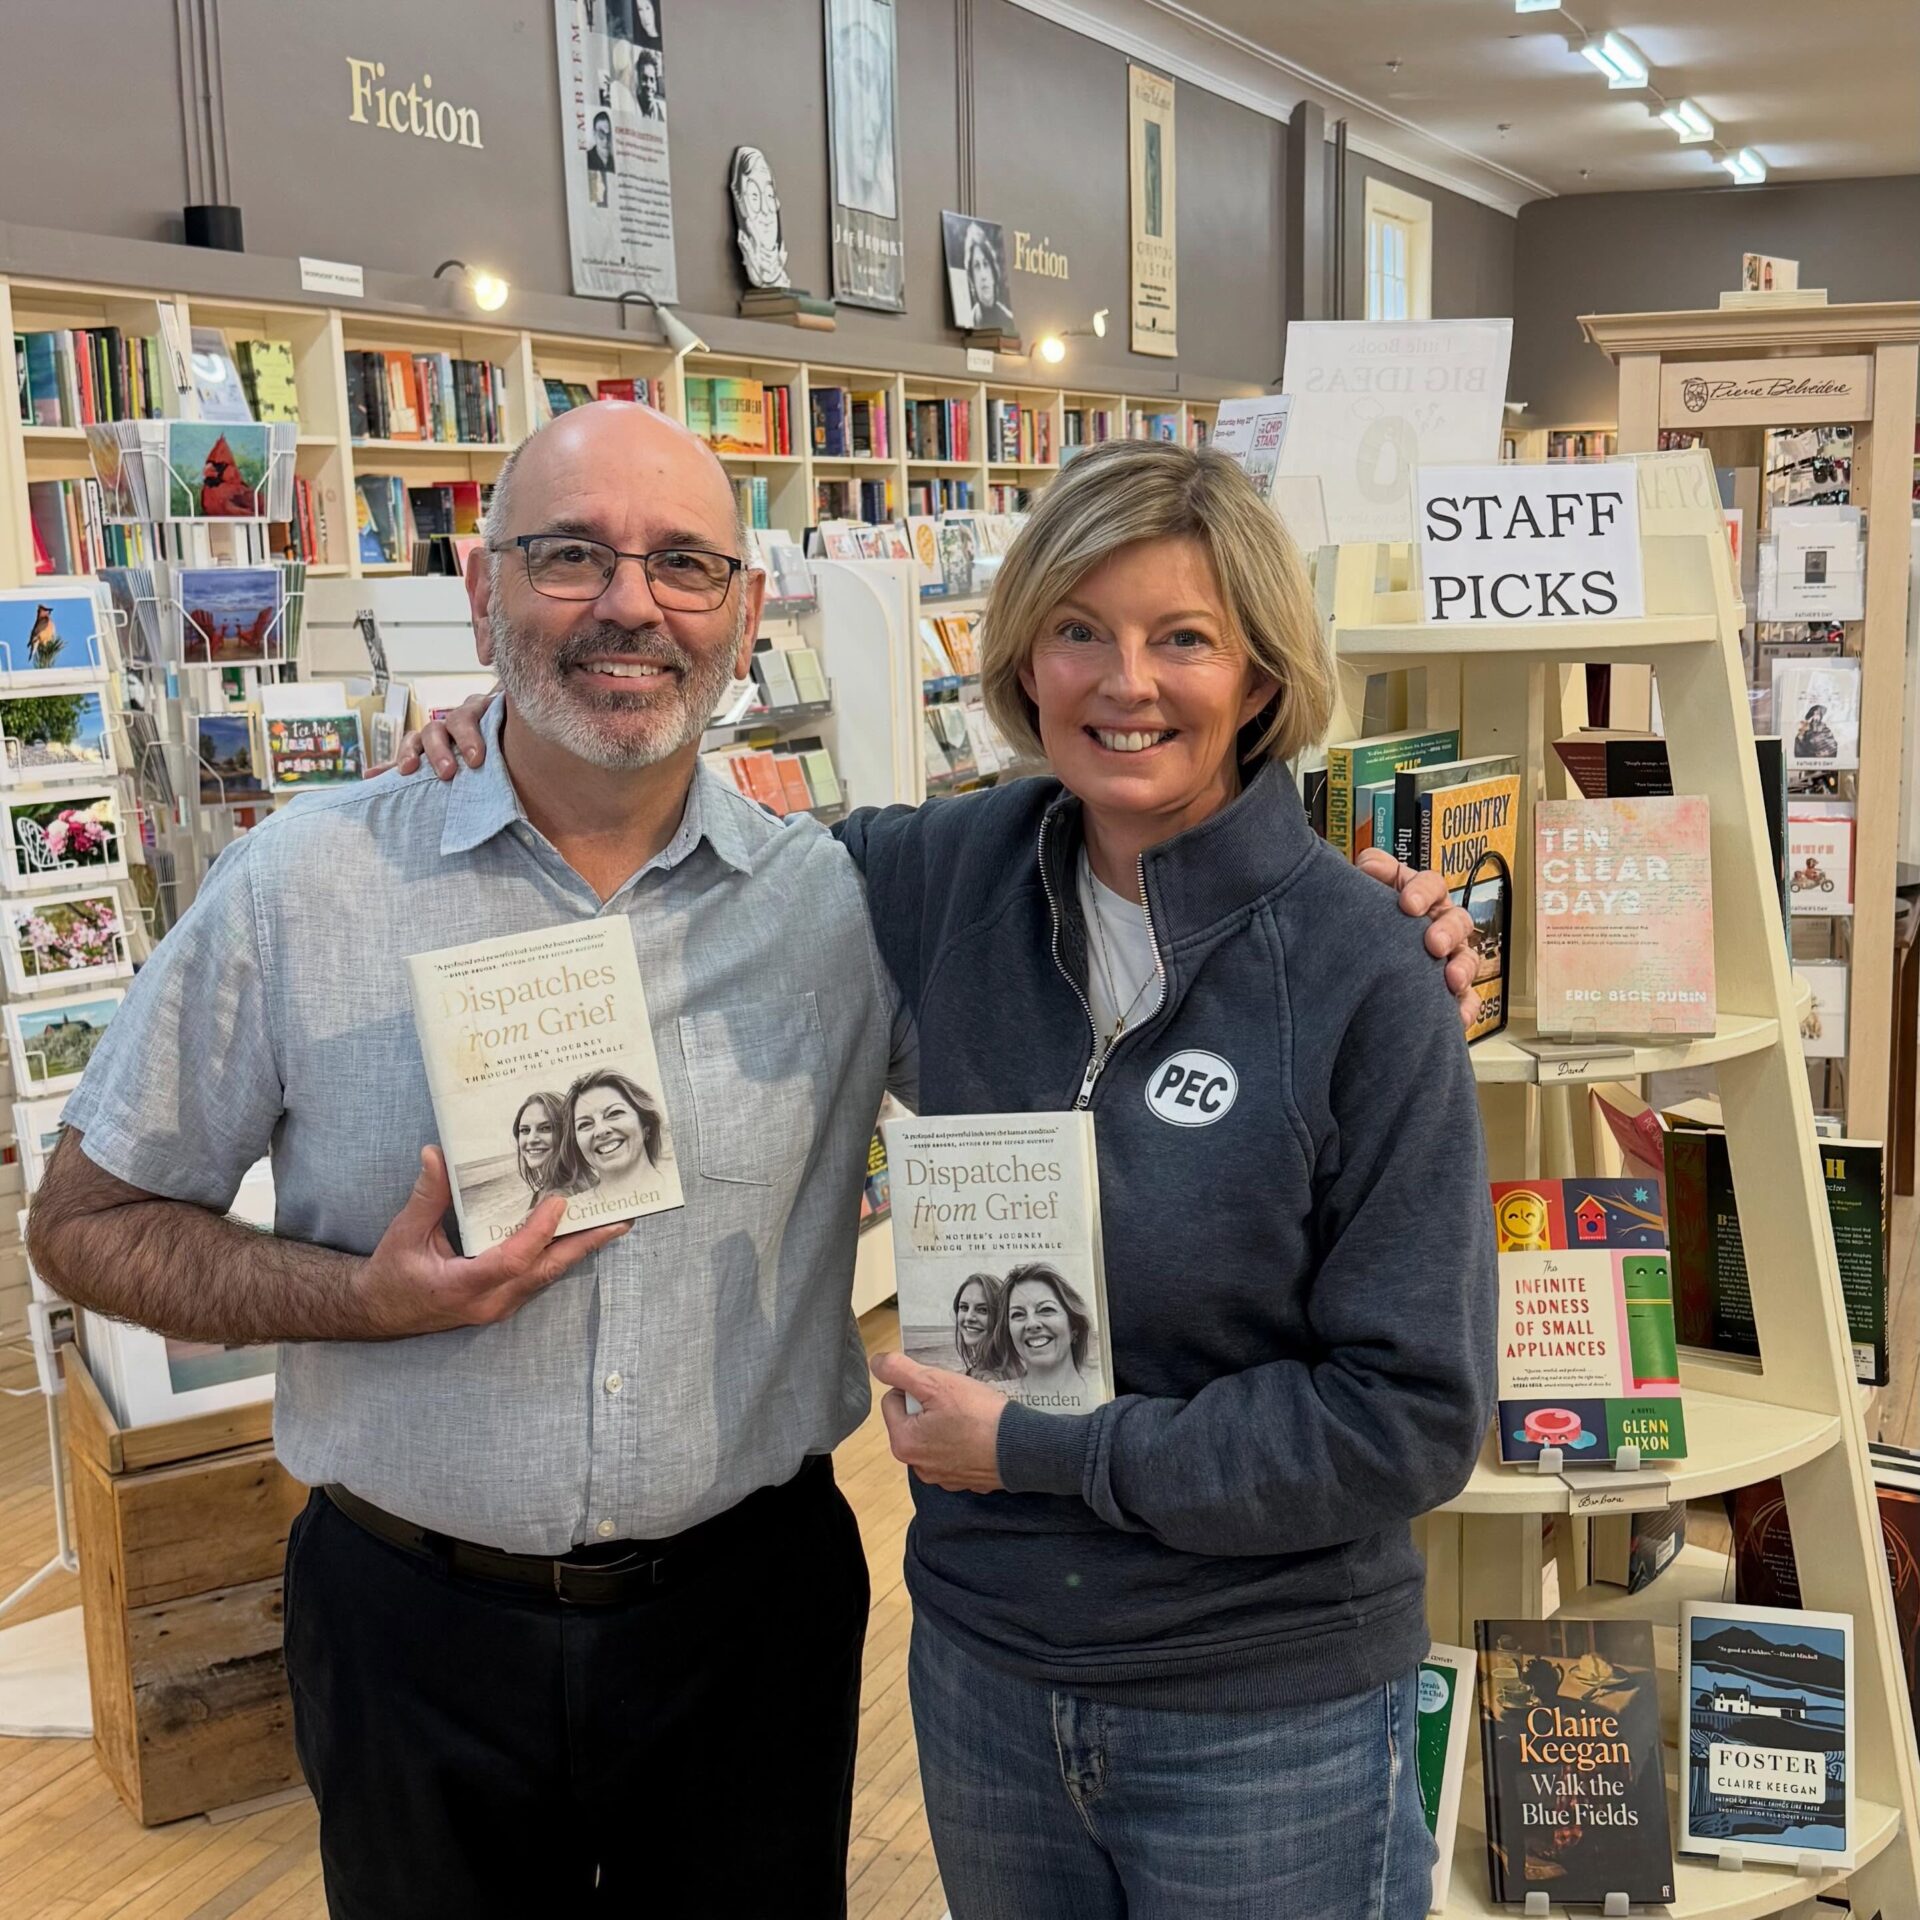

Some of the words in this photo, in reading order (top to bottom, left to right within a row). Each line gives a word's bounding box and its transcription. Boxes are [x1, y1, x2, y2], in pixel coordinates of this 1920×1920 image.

[570, 21, 588, 152] EMBLEM
[345, 56, 484, 149] Fiction
[1014, 231, 1069, 280] Fiction
[1701, 380, 1764, 399] Pierre
[1265, 420, 1283, 434] CHIP
[1254, 434, 1279, 448] STAND
[1425, 492, 1624, 542] STAFF
[1429, 571, 1620, 621] PICKS
[1332, 755, 1347, 781] THE
[1442, 794, 1512, 840] COUNTRY
[1421, 809, 1431, 871] COUNTRY
[1541, 827, 1611, 853] TEN
[1542, 856, 1671, 884] CLEAR
[1542, 889, 1642, 916] DAYS
[440, 964, 617, 1019] Dispatches
[1565, 989, 1602, 1002] ERIC
[1656, 990, 1707, 1004] RUBIN
[537, 994, 618, 1037] Grief
[496, 1048, 550, 1066] MOTHER'S
[555, 1038, 603, 1054] JOURNEY
[464, 1067, 517, 1085] THROUGH
[523, 1062, 544, 1072] THE
[1154, 1063, 1228, 1114] PEC
[904, 1154, 1062, 1193] Dispatches
[566, 1189, 661, 1221] Crittenden
[912, 1195, 977, 1229] from
[985, 1192, 1059, 1222] Grief
[917, 1244, 962, 1252] THROUGH
[968, 1243, 986, 1251] THE
[992, 1241, 1064, 1250] UNTHINKABLE
[945, 1232, 993, 1241] MOTHER'S
[999, 1231, 1043, 1240] JOURNEY
[1543, 1259, 1558, 1273] The
[1515, 1277, 1587, 1295] INFINITE
[1515, 1298, 1590, 1316] SADNESS
[1515, 1320, 1535, 1337] OF
[1542, 1320, 1595, 1336] SMALL
[1506, 1340, 1607, 1359] APPLIANCES
[1637, 1407, 1656, 1415] NOVEL
[1622, 1418, 1669, 1434] GLENN
[1624, 1436, 1669, 1451] DIXON
[1527, 1707, 1619, 1739] Claire
[1519, 1733, 1631, 1772] Keegan
[1719, 1750, 1818, 1776] FOSTER
[1530, 1773, 1586, 1797] Walk
[1589, 1773, 1625, 1797] the
[1717, 1776, 1762, 1791] CLAIRE
[1766, 1780, 1818, 1796] KEEGAN
[1522, 1803, 1570, 1826] Blue
[1575, 1803, 1639, 1827] Fields
